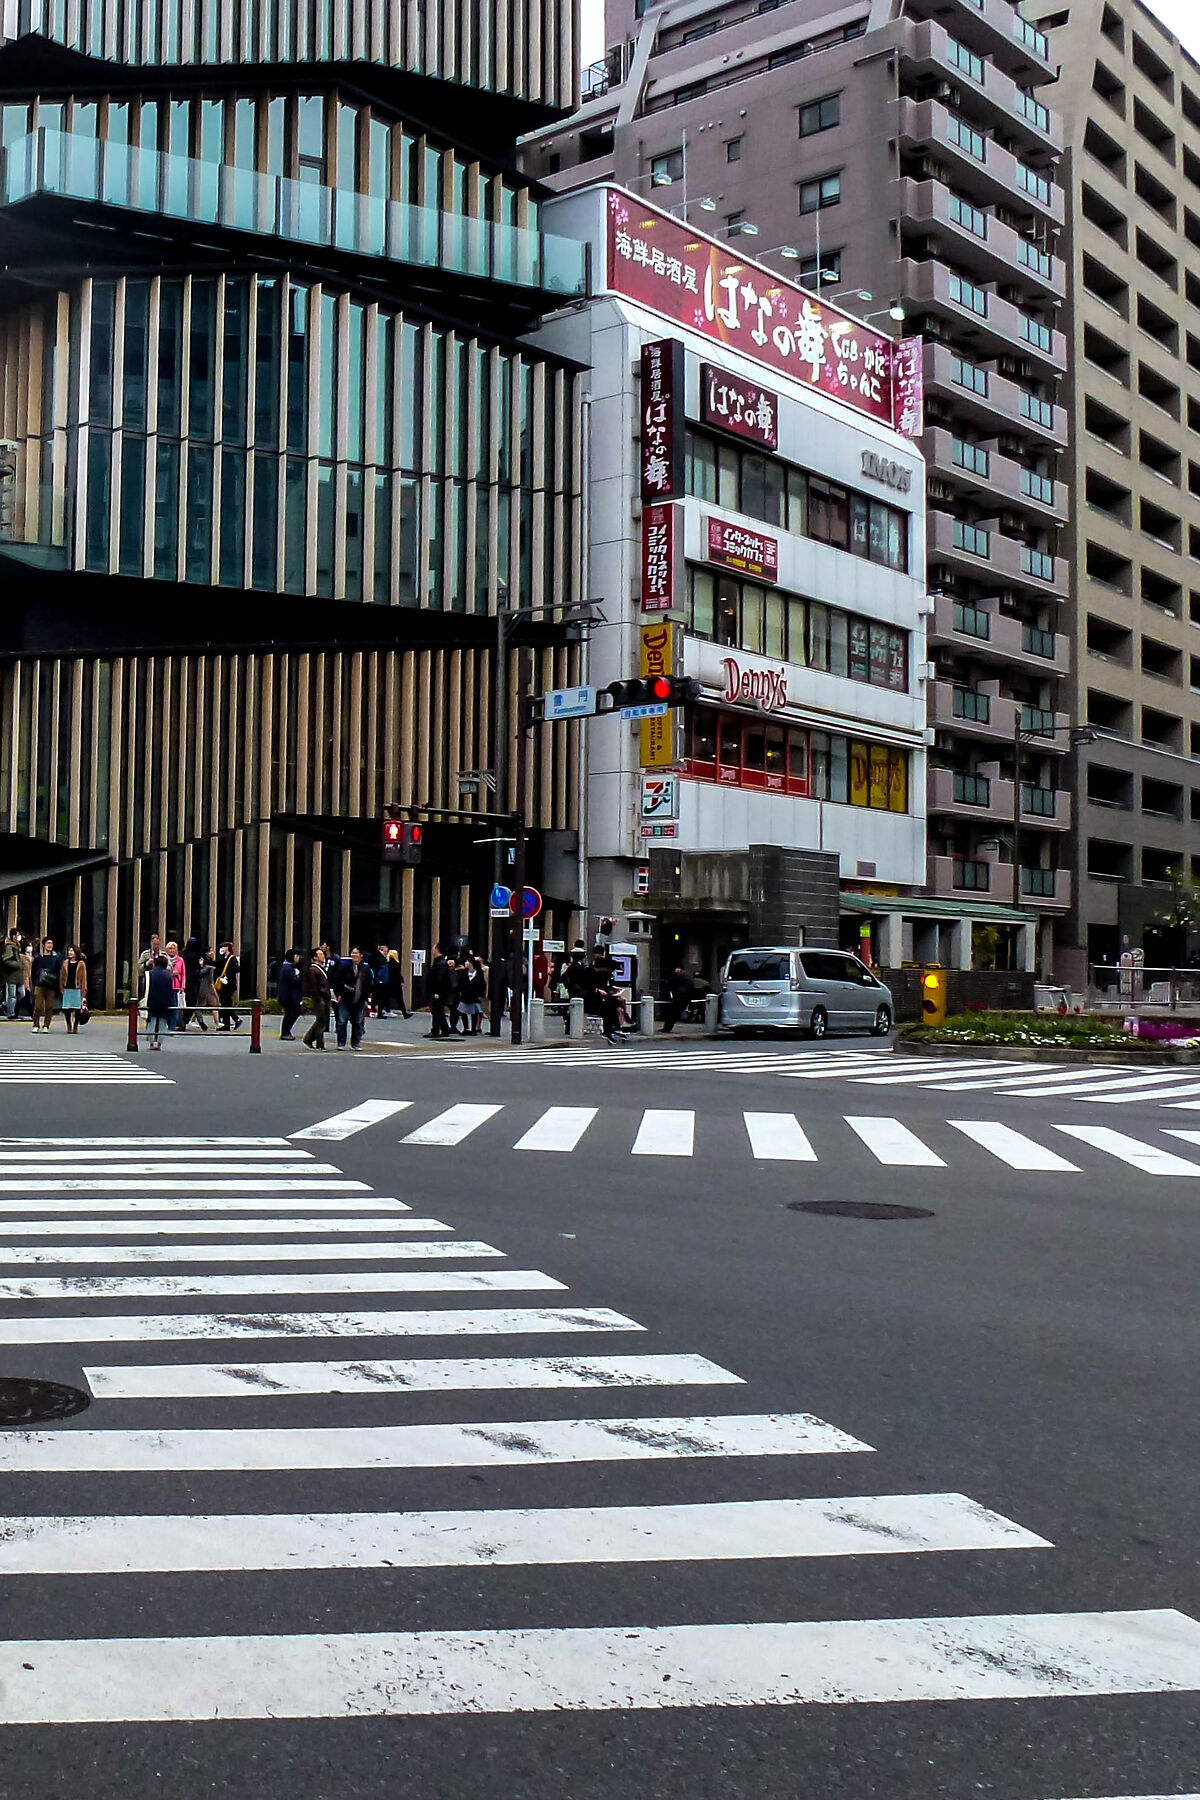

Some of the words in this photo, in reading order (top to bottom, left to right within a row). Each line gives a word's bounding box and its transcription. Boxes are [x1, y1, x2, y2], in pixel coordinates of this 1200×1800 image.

[616, 231, 699, 294] 海鮮居酒屋
[703, 265, 829, 381] はなの舞
[710, 381, 774, 440] はなの舞
[837, 361, 882, 403] ちゃんこ
[897, 360, 918, 435] はなの舞
[644, 403, 670, 490] はなの舞
[721, 657, 788, 713] Denny's
